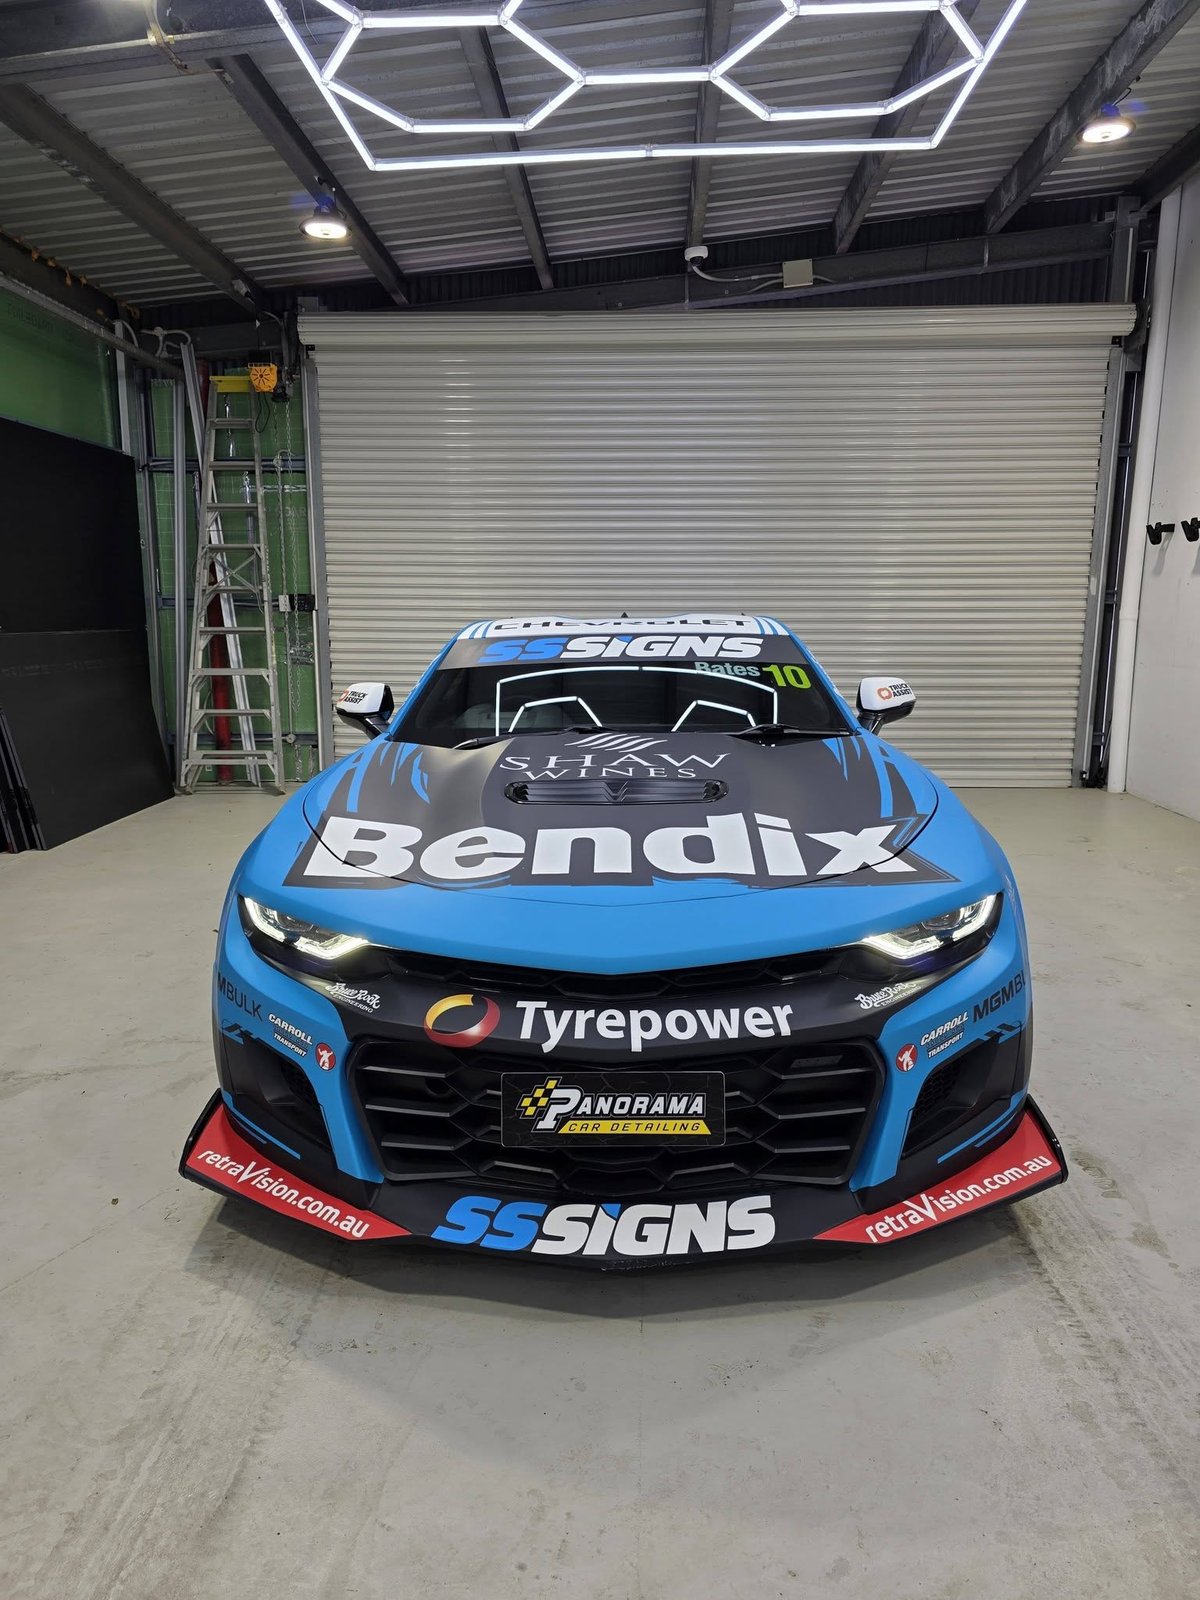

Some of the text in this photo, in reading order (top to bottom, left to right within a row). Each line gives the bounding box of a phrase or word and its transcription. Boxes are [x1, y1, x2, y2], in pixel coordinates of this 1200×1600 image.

[694, 661, 812, 690] Bates 10
[888, 683, 908, 692] TRUCK
[349, 691, 368, 699] TRUCK
[893, 688, 912, 697] ASSIST
[499, 753, 732, 771] SHAW
[522, 767, 698, 781] WINES
[303, 813, 918, 880] Bendix
[356, 989, 381, 1009] Rock
[268, 1013, 313, 1045] CARROLL
[515, 1000, 794, 1053] Tyrepower
[920, 1011, 969, 1046] CARROLL
[273, 1032, 308, 1058] TRANSPORT
[927, 1031, 964, 1058] TRANSPORT
[536, 1088, 704, 1129] PANORAMA
[568, 1122, 701, 1132] CAR DETAILING
[197, 1149, 370, 1239] retraVision.com.au
[865, 1154, 1053, 1244] retraVision.com.au
